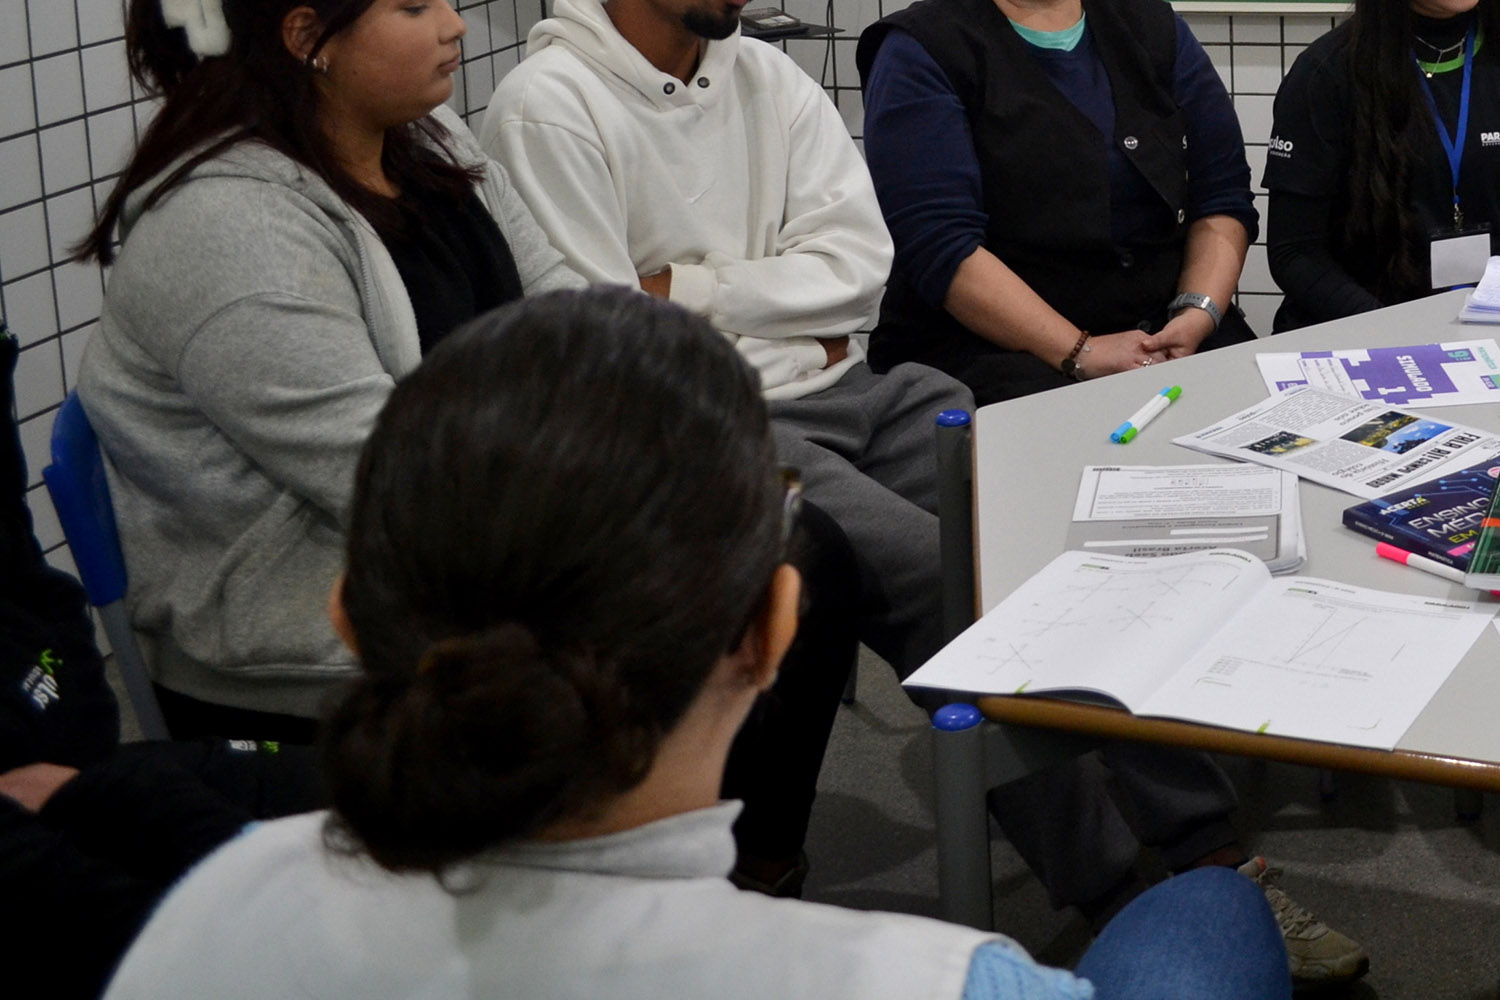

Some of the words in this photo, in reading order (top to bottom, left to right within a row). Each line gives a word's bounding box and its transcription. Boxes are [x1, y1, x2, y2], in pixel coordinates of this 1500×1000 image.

[1396, 355, 1433, 393] SIMULADO
[1444, 432, 1481, 450] FALA
[1366, 466, 1402, 488] MAGRO
[1379, 496, 1427, 516] ACERTA
[1448, 529, 1479, 543] EM
